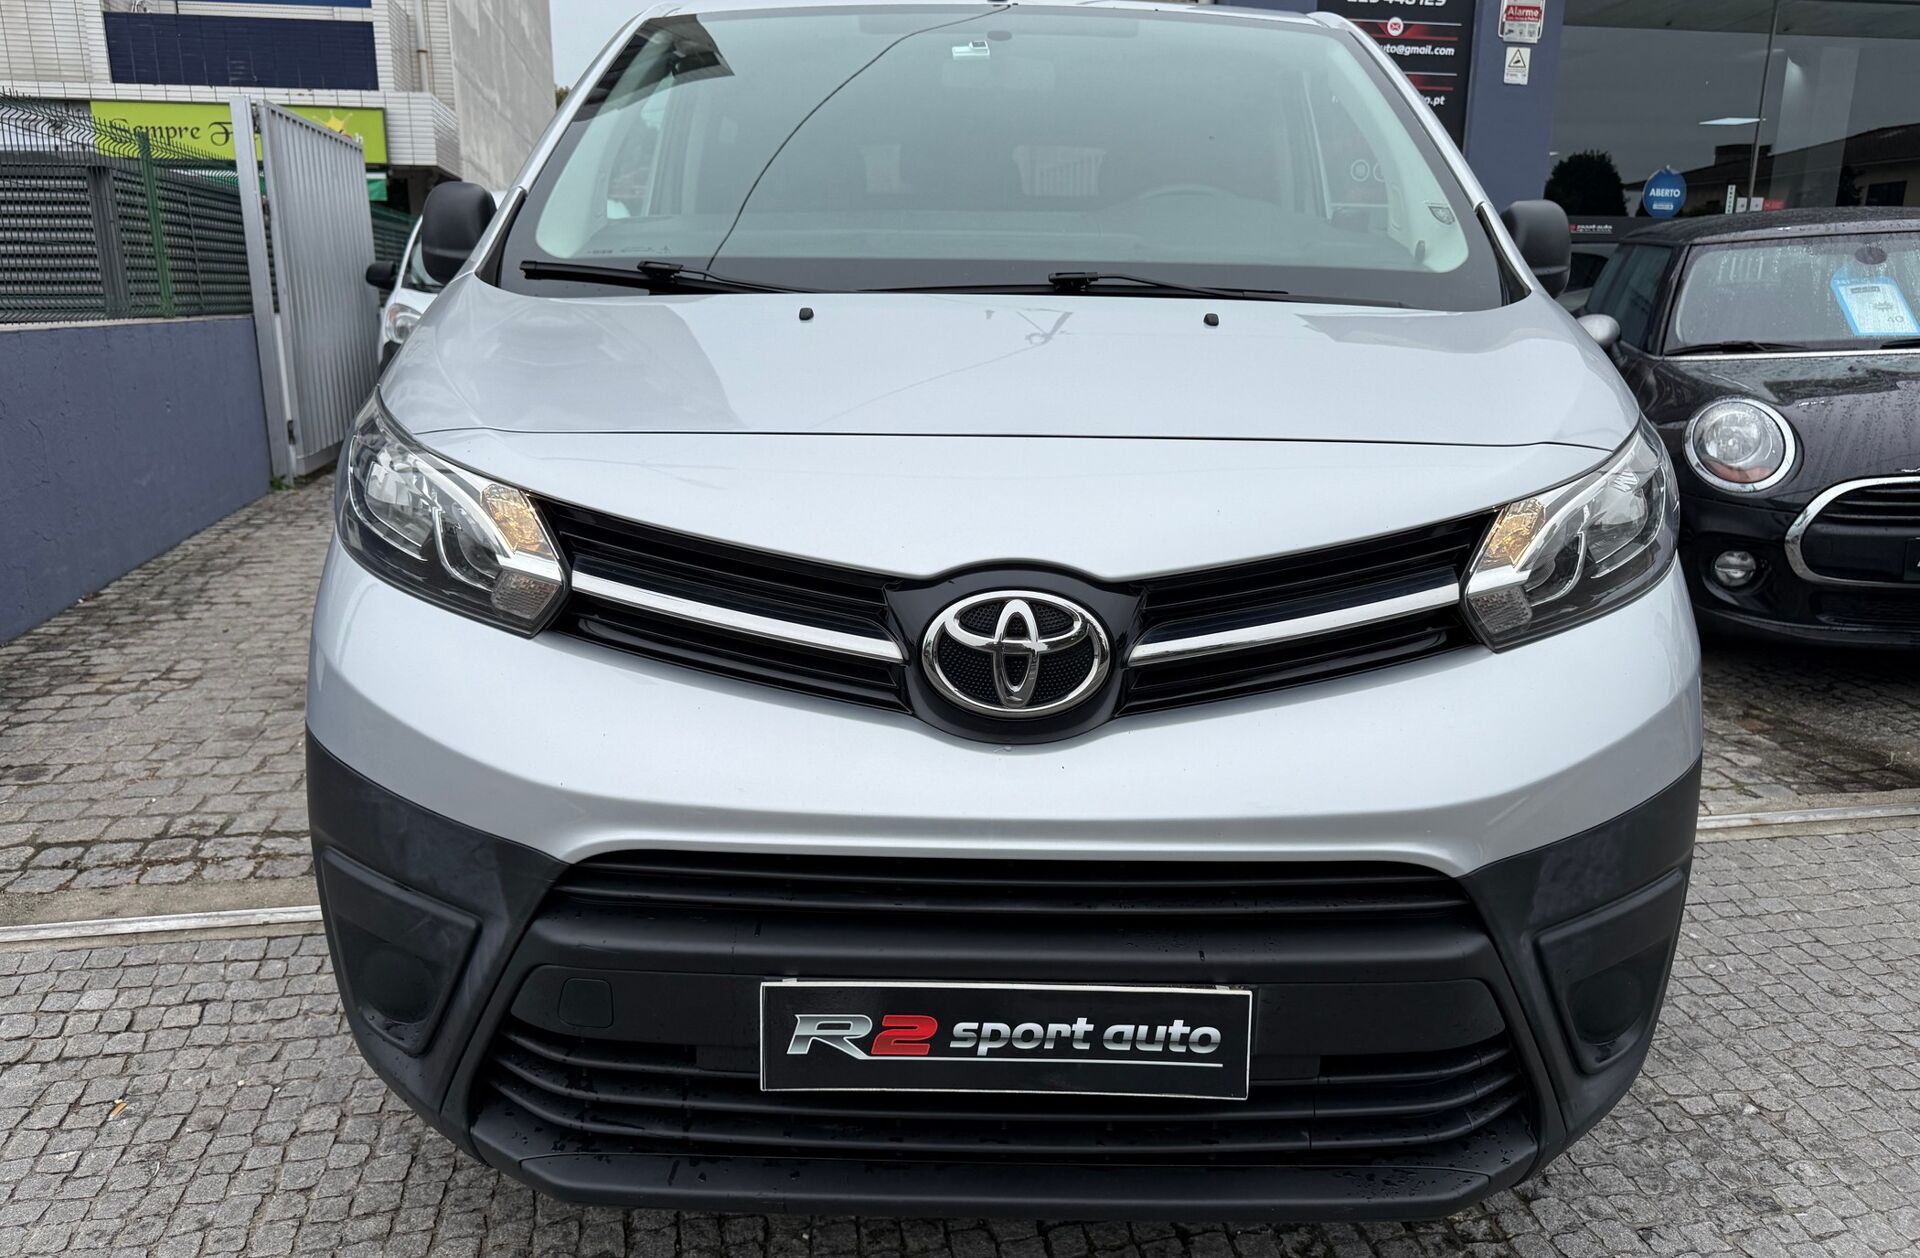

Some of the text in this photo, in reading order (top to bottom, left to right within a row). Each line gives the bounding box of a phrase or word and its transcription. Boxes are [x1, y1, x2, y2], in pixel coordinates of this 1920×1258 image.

[1507, 6, 1540, 17] Alarme
[1649, 188, 1681, 198] ABERTO
[787, 1014, 1222, 1060] R2 sport auto
